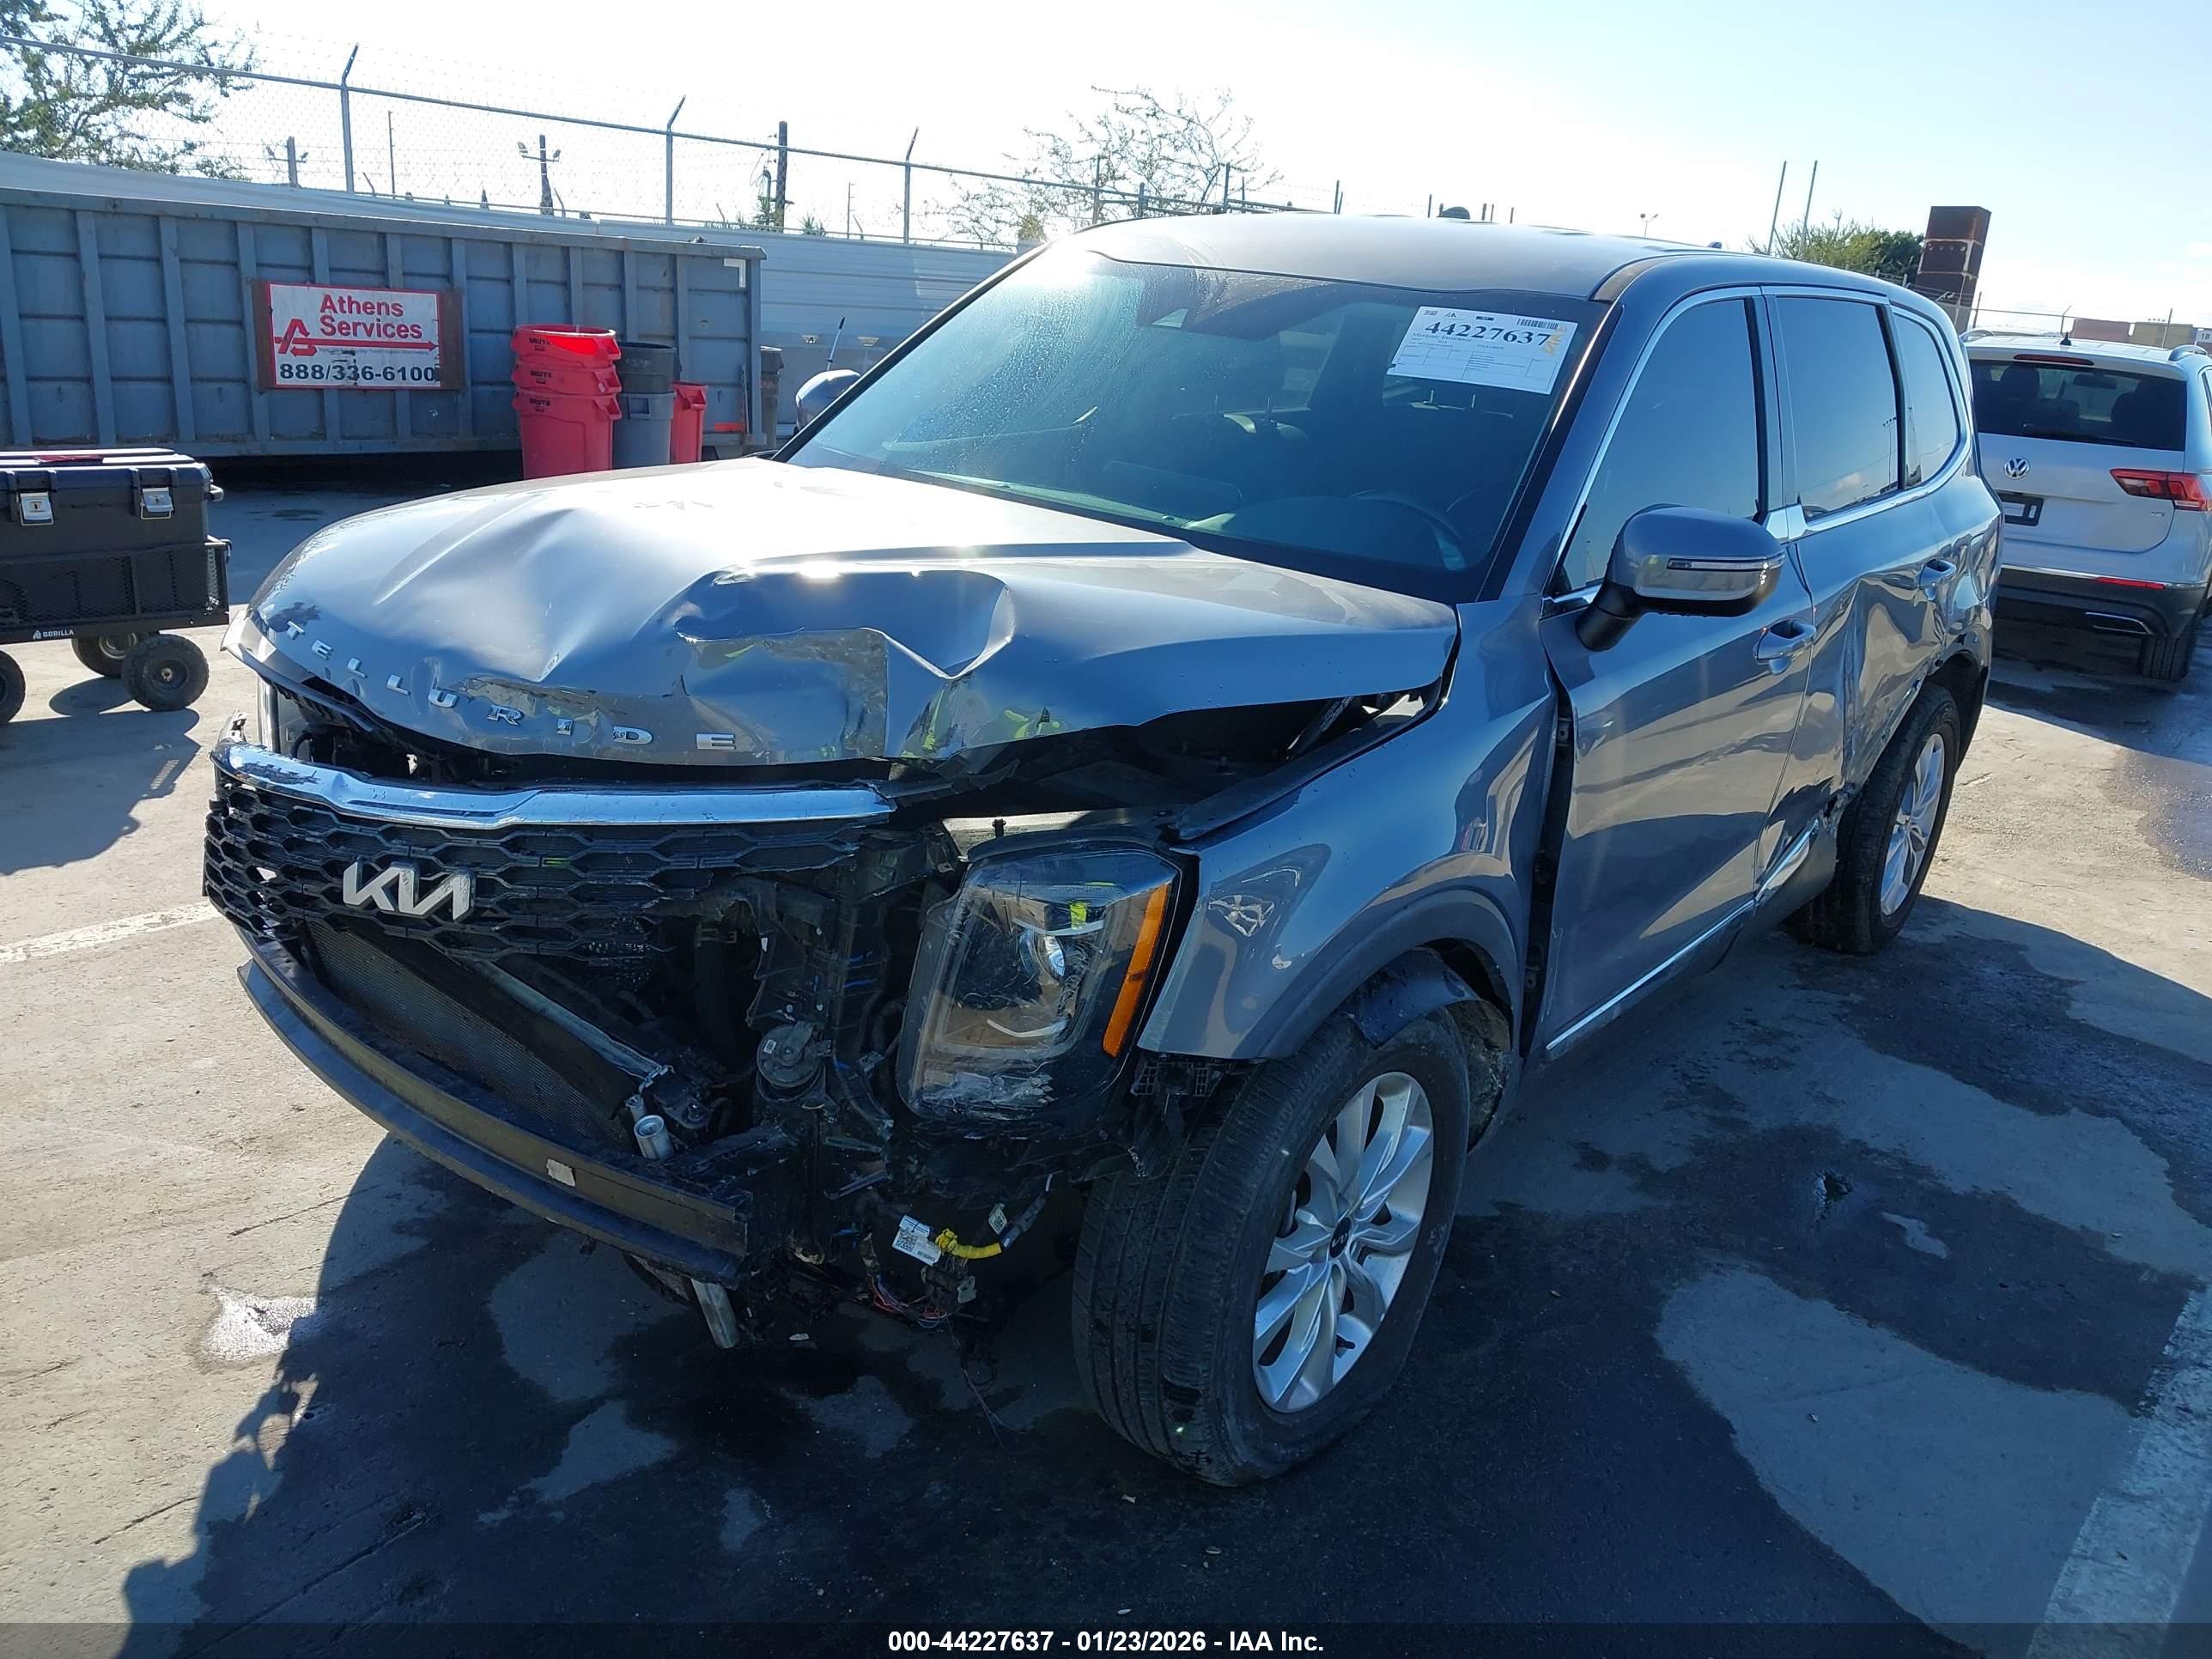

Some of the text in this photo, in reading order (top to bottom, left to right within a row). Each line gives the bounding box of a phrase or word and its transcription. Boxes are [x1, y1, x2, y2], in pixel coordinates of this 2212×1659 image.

[319, 294, 404, 317] Athens
[319, 314, 422, 339] Services
[1425, 321, 1551, 346] 44227637
[279, 363, 435, 381] 888/336-6100
[42, 629, 75, 638] GORILLA
[287, 620, 737, 751] TELLURIDE
[343, 860, 473, 922] KIA
